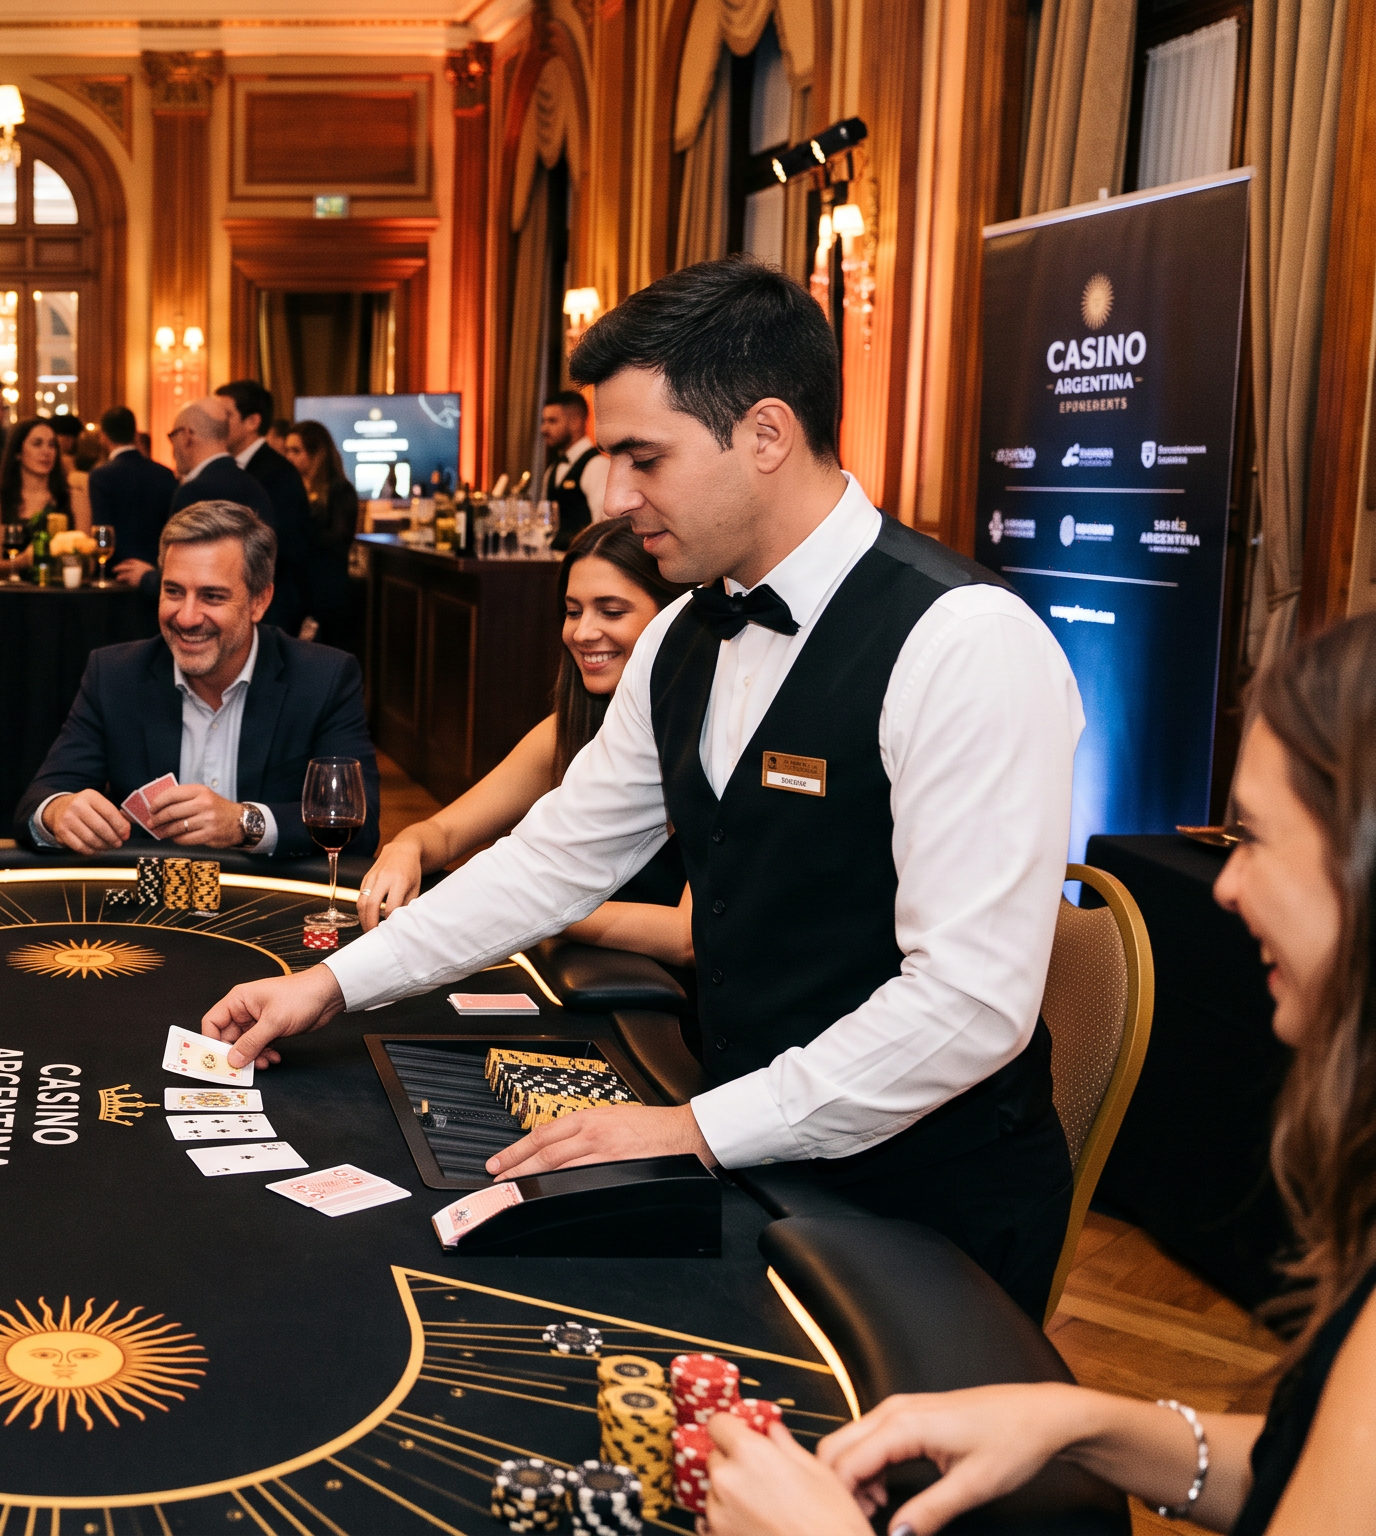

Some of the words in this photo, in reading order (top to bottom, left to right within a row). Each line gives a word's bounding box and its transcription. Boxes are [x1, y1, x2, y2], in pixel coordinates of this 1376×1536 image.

[1046, 331, 1147, 373] CASINO
[1054, 372, 1134, 395] ARGENTINA
[32, 1063, 82, 1145] CASINO
